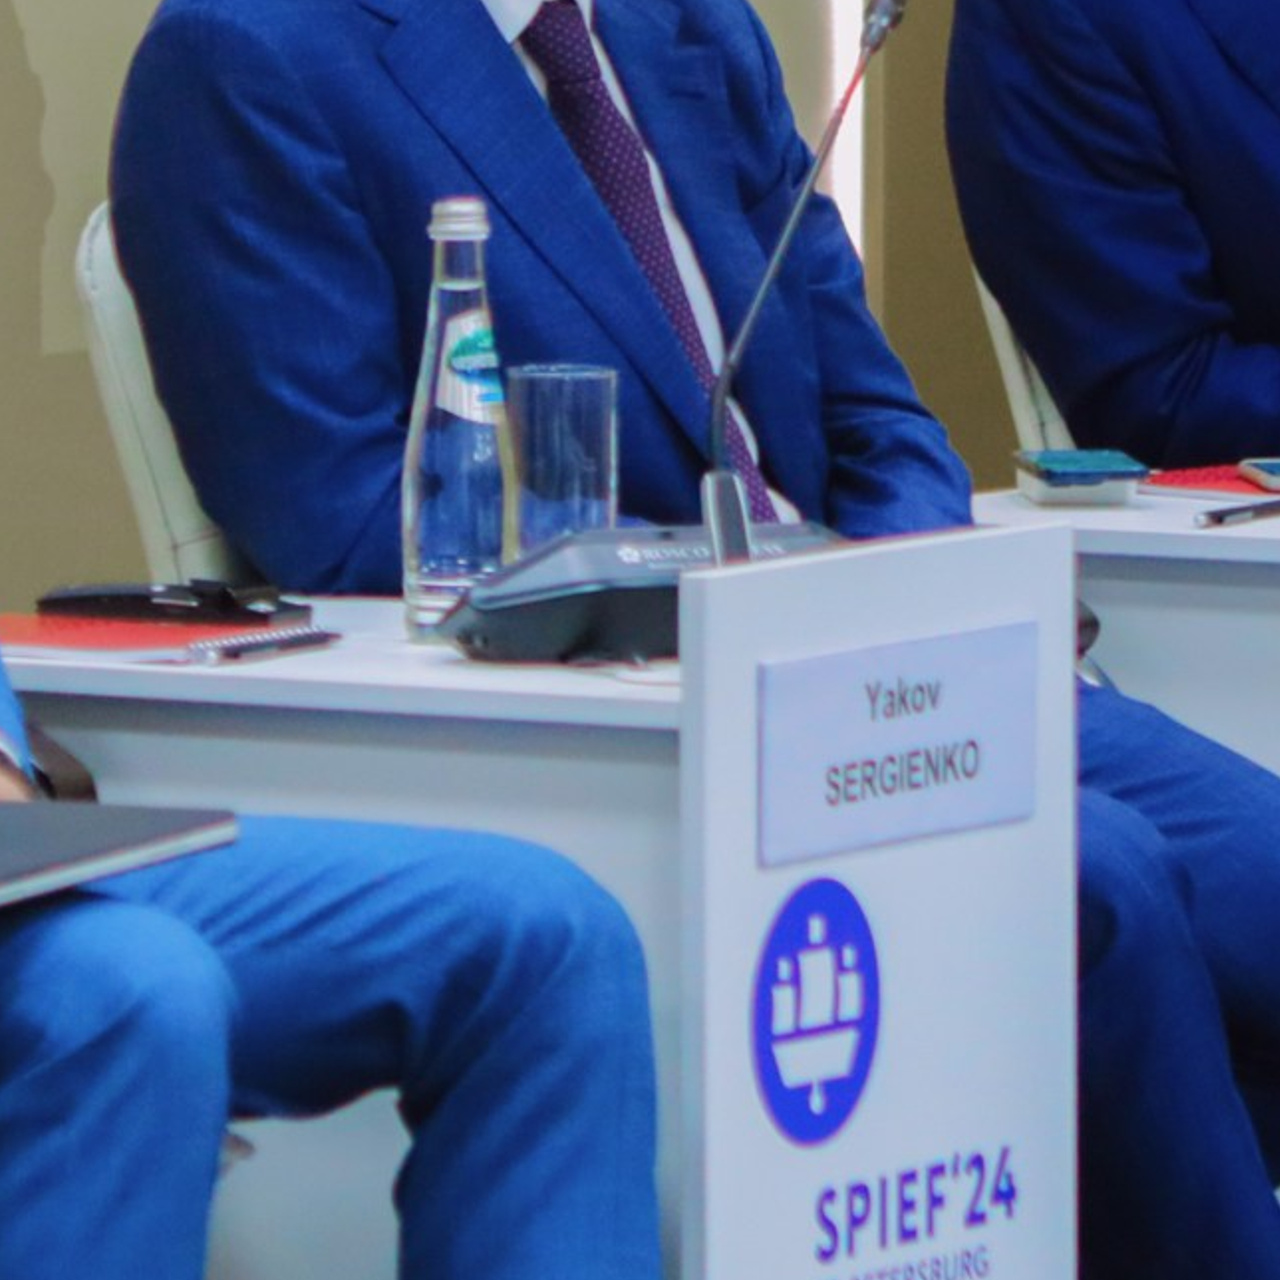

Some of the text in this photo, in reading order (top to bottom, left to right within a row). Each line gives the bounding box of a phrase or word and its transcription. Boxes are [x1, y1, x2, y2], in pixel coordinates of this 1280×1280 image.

[865, 676, 941, 721] Yakov
[824, 738, 980, 807] SERGIENKO
[816, 1145, 1017, 1264] SPIEF'24
